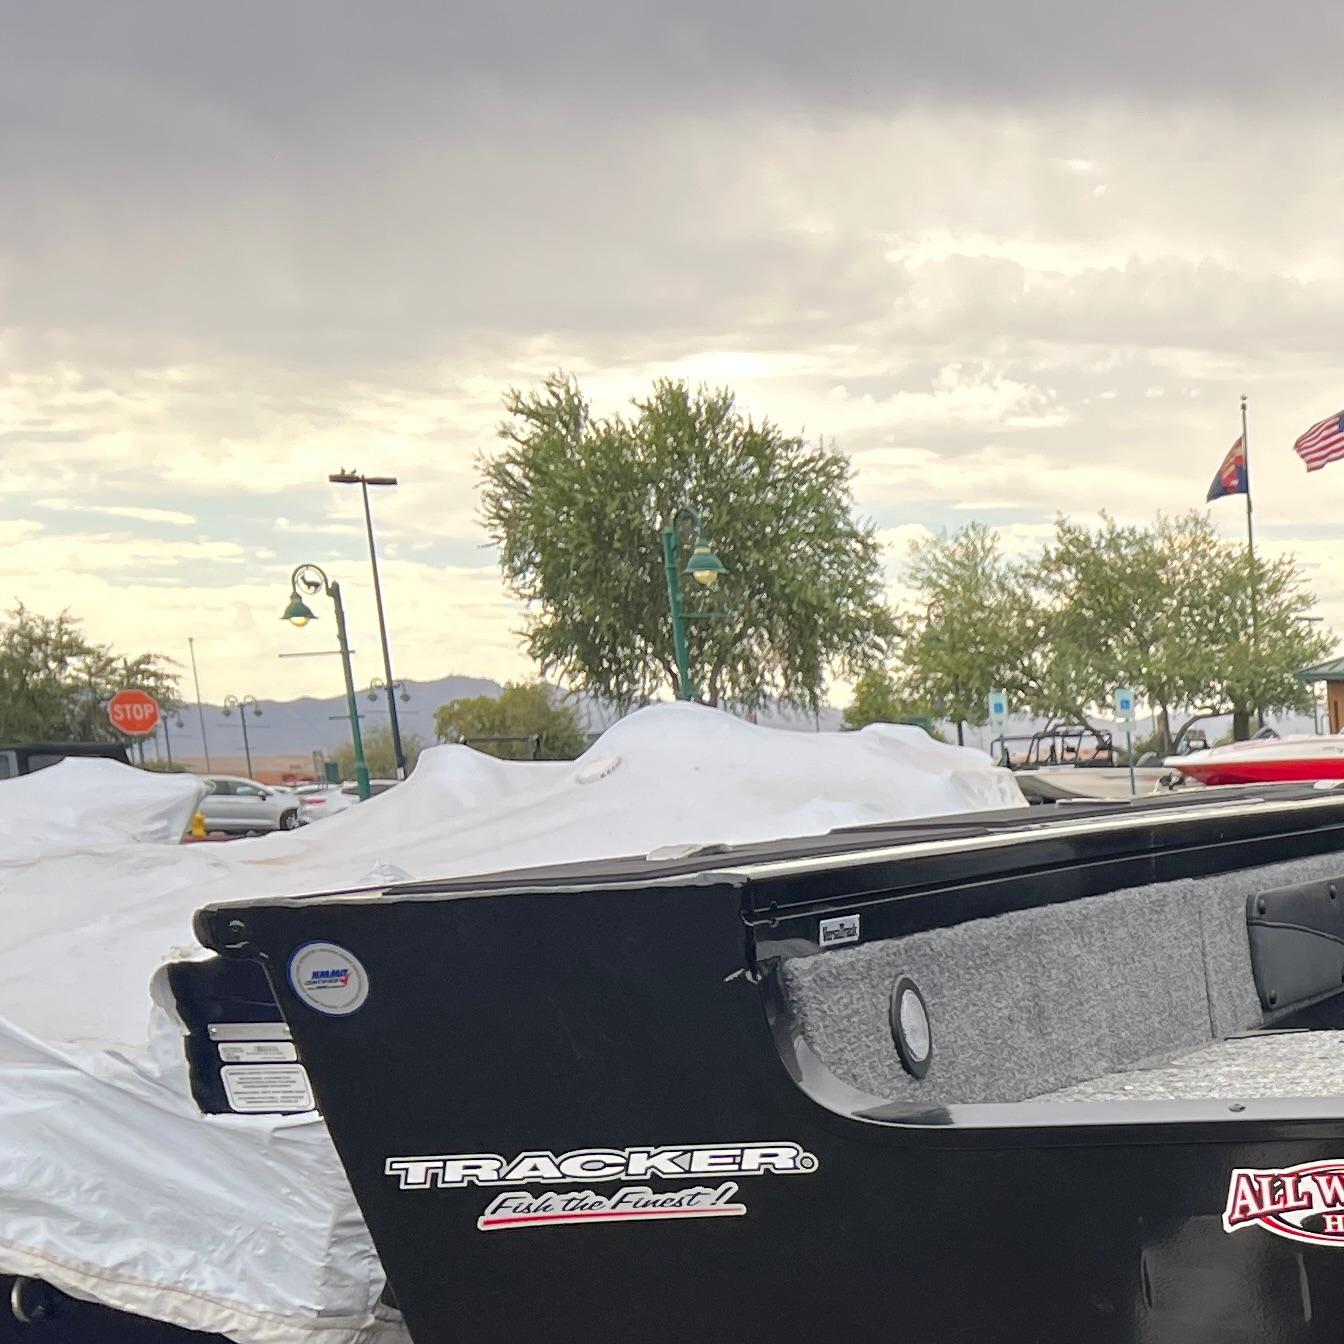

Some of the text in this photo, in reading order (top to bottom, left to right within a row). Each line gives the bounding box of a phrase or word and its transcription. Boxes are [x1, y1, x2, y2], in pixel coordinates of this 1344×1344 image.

[113, 703, 155, 721] STOP
[390, 1145, 801, 1186] TRACKER
[490, 1196, 554, 1215] Fish
[561, 1194, 607, 1213] the
[1228, 1173, 1313, 1226] ALL
